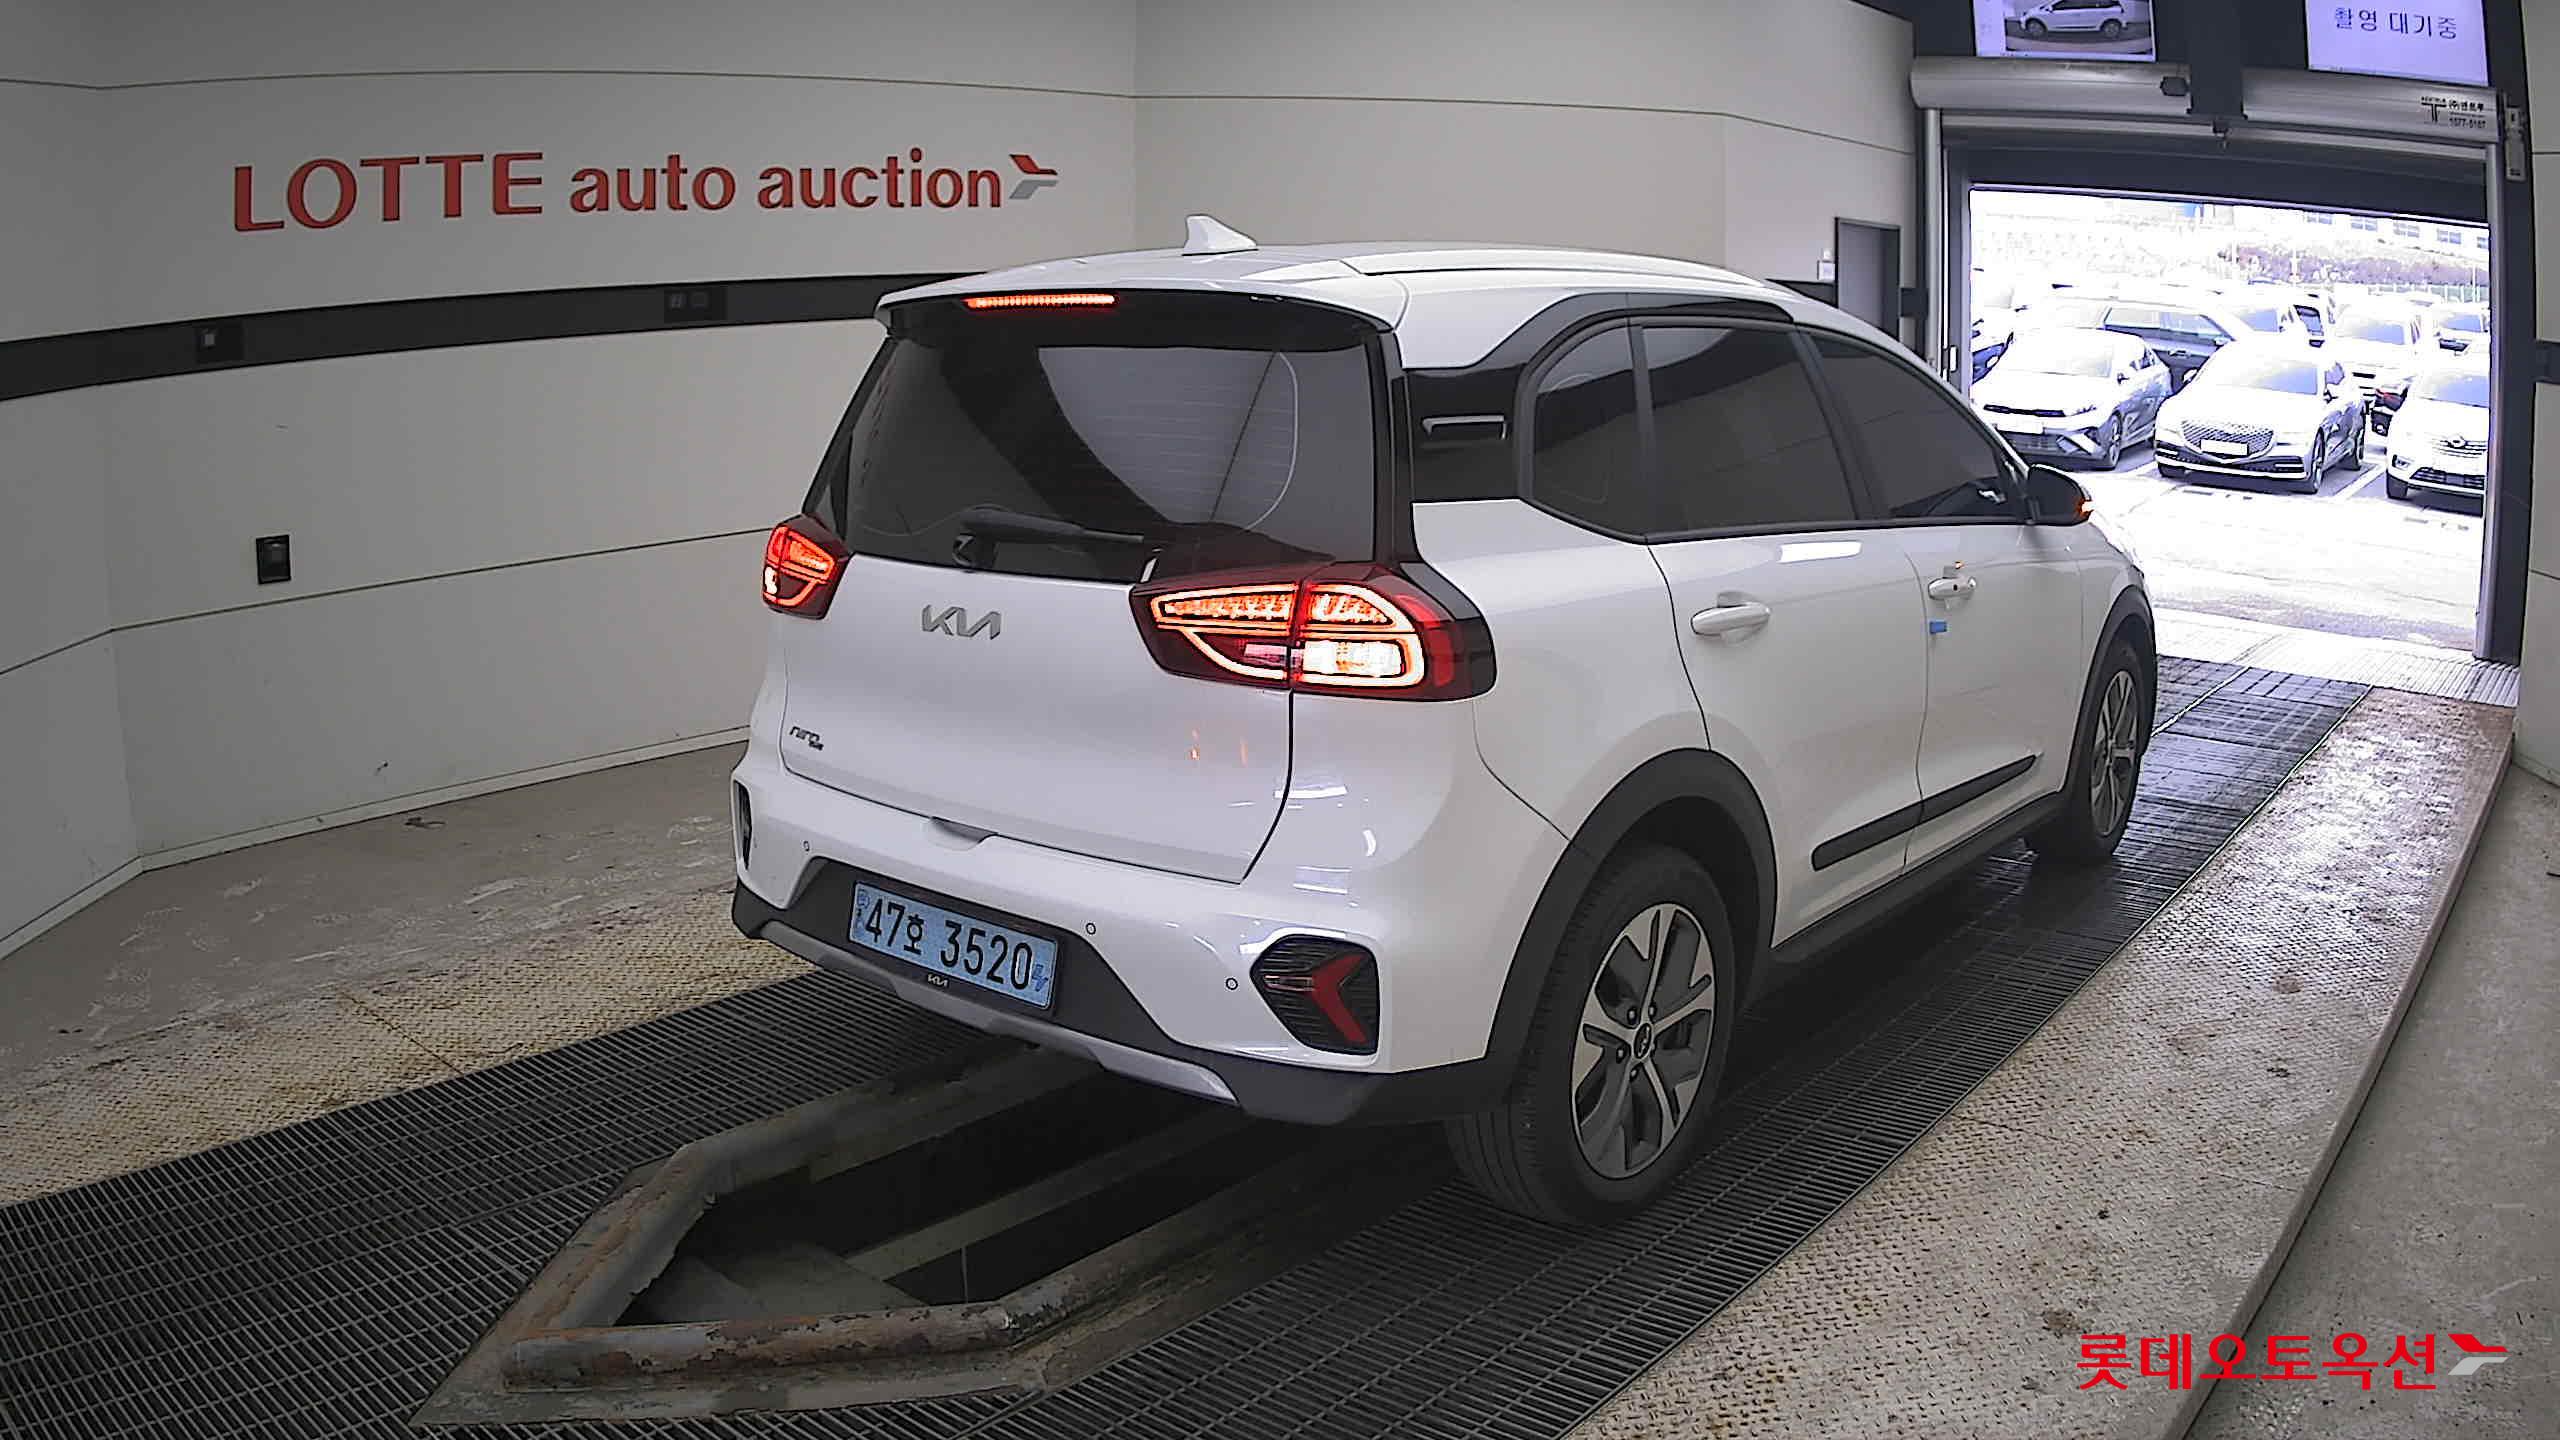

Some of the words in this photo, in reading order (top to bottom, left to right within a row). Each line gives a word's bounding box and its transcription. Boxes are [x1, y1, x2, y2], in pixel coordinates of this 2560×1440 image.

[235, 152, 543, 232] LOTTE
[570, 154, 737, 212] auto
[758, 147, 1002, 209] auction
[865, 898, 925, 955] 47호
[941, 920, 1033, 990] 3520
